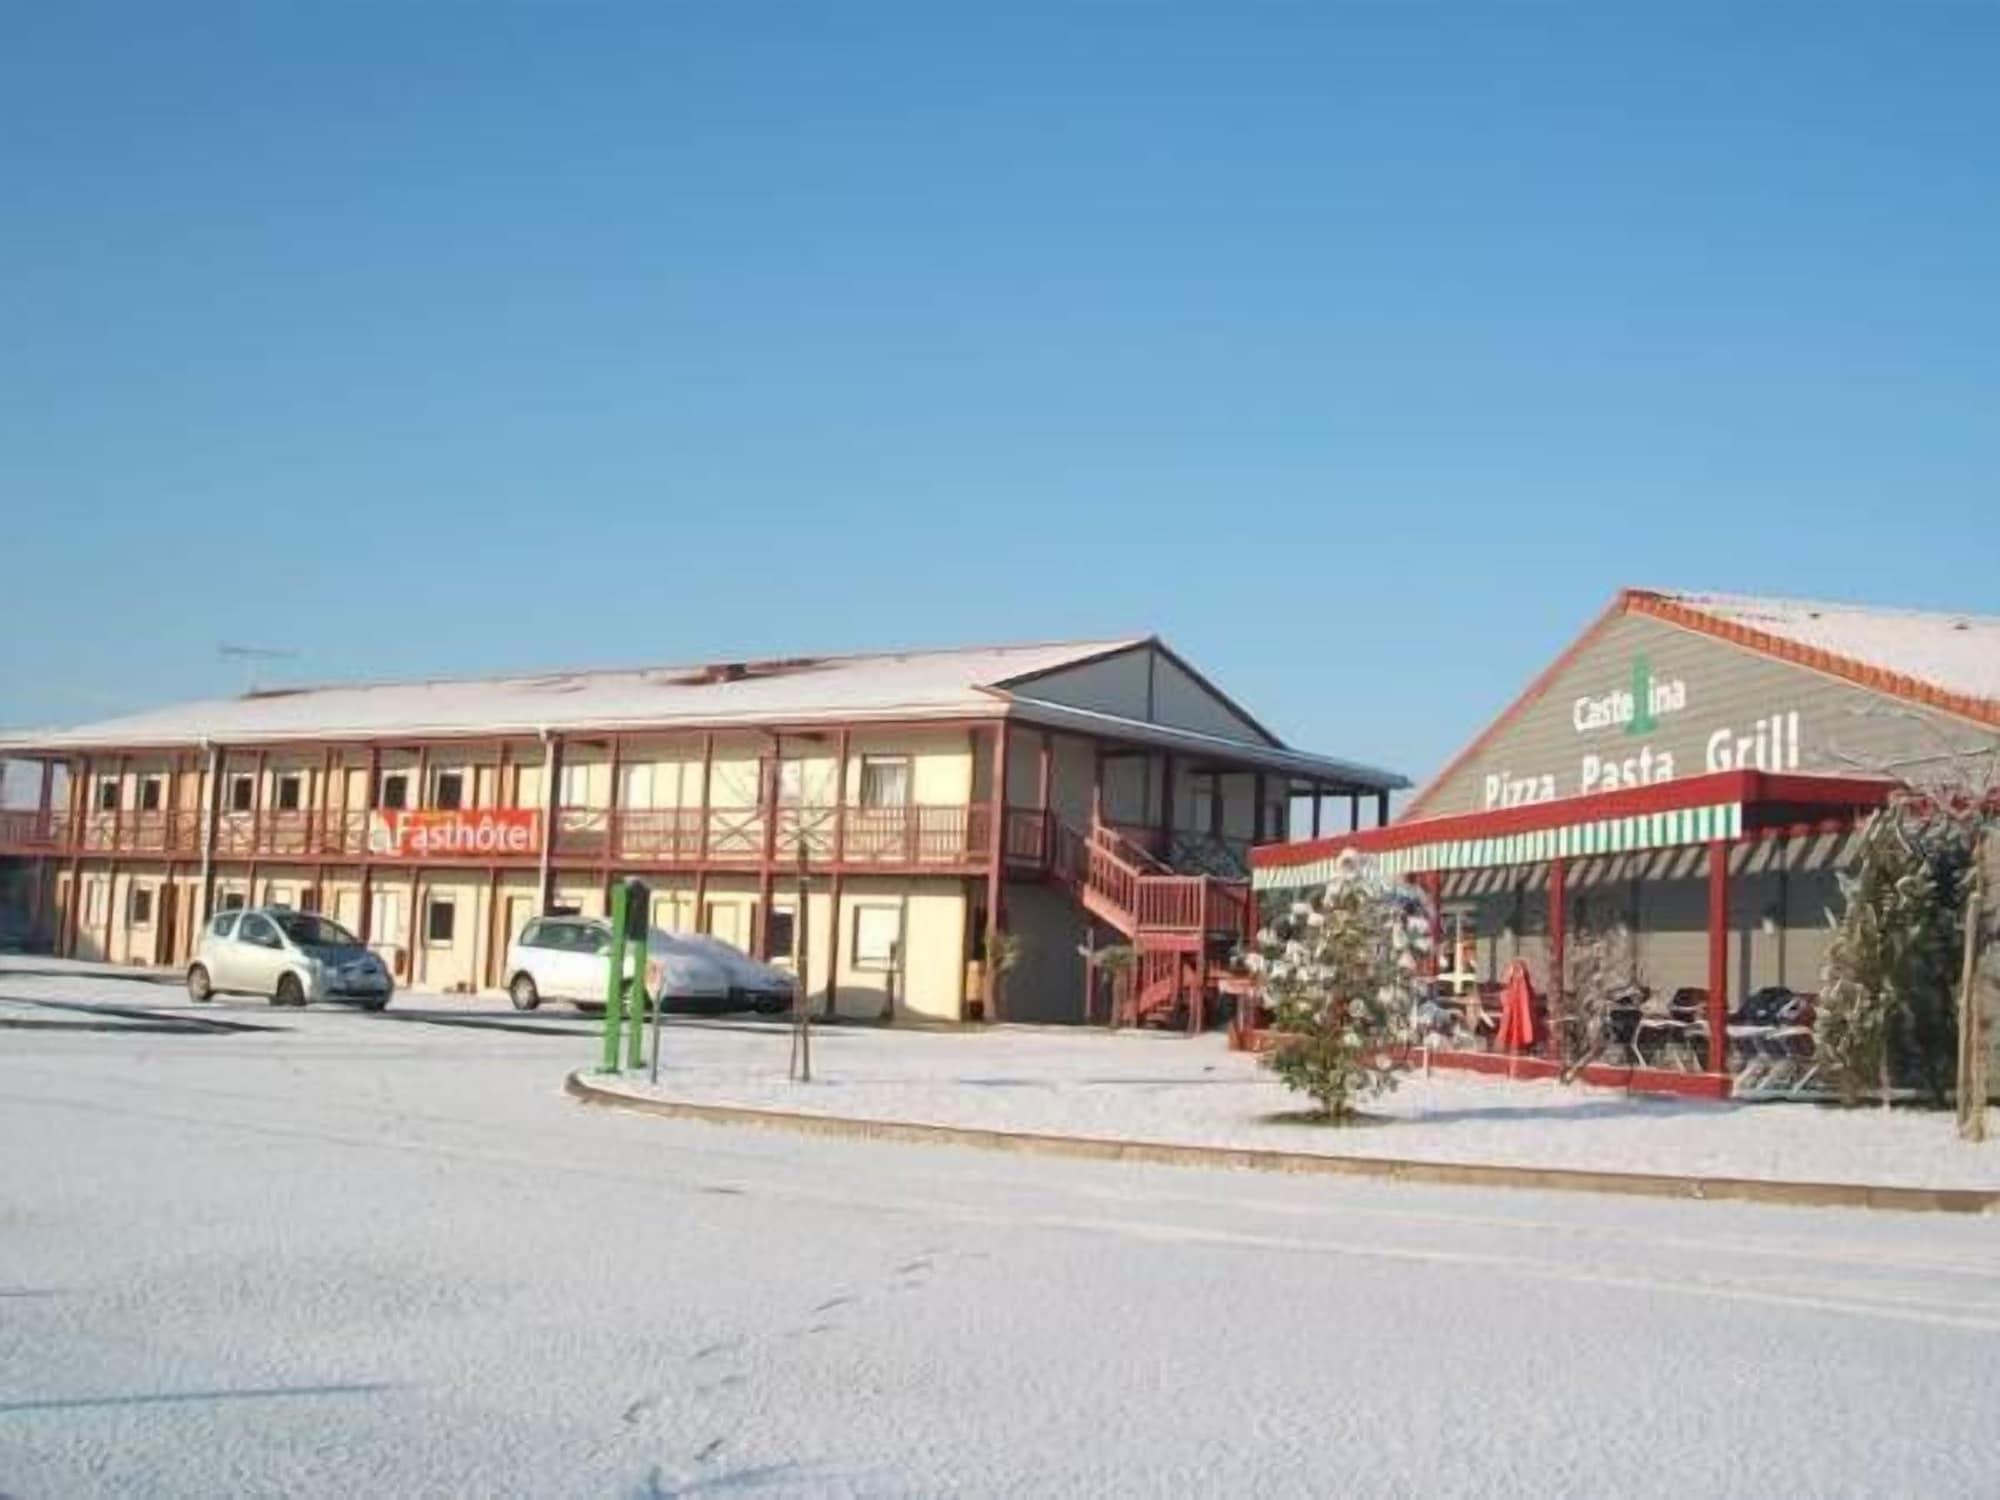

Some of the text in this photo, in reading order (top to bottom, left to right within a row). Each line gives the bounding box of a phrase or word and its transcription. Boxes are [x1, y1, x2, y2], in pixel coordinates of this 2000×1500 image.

[1485, 711, 1799, 811] Pizza Pasta Grill
[396, 812, 538, 852] Fasthôtel
